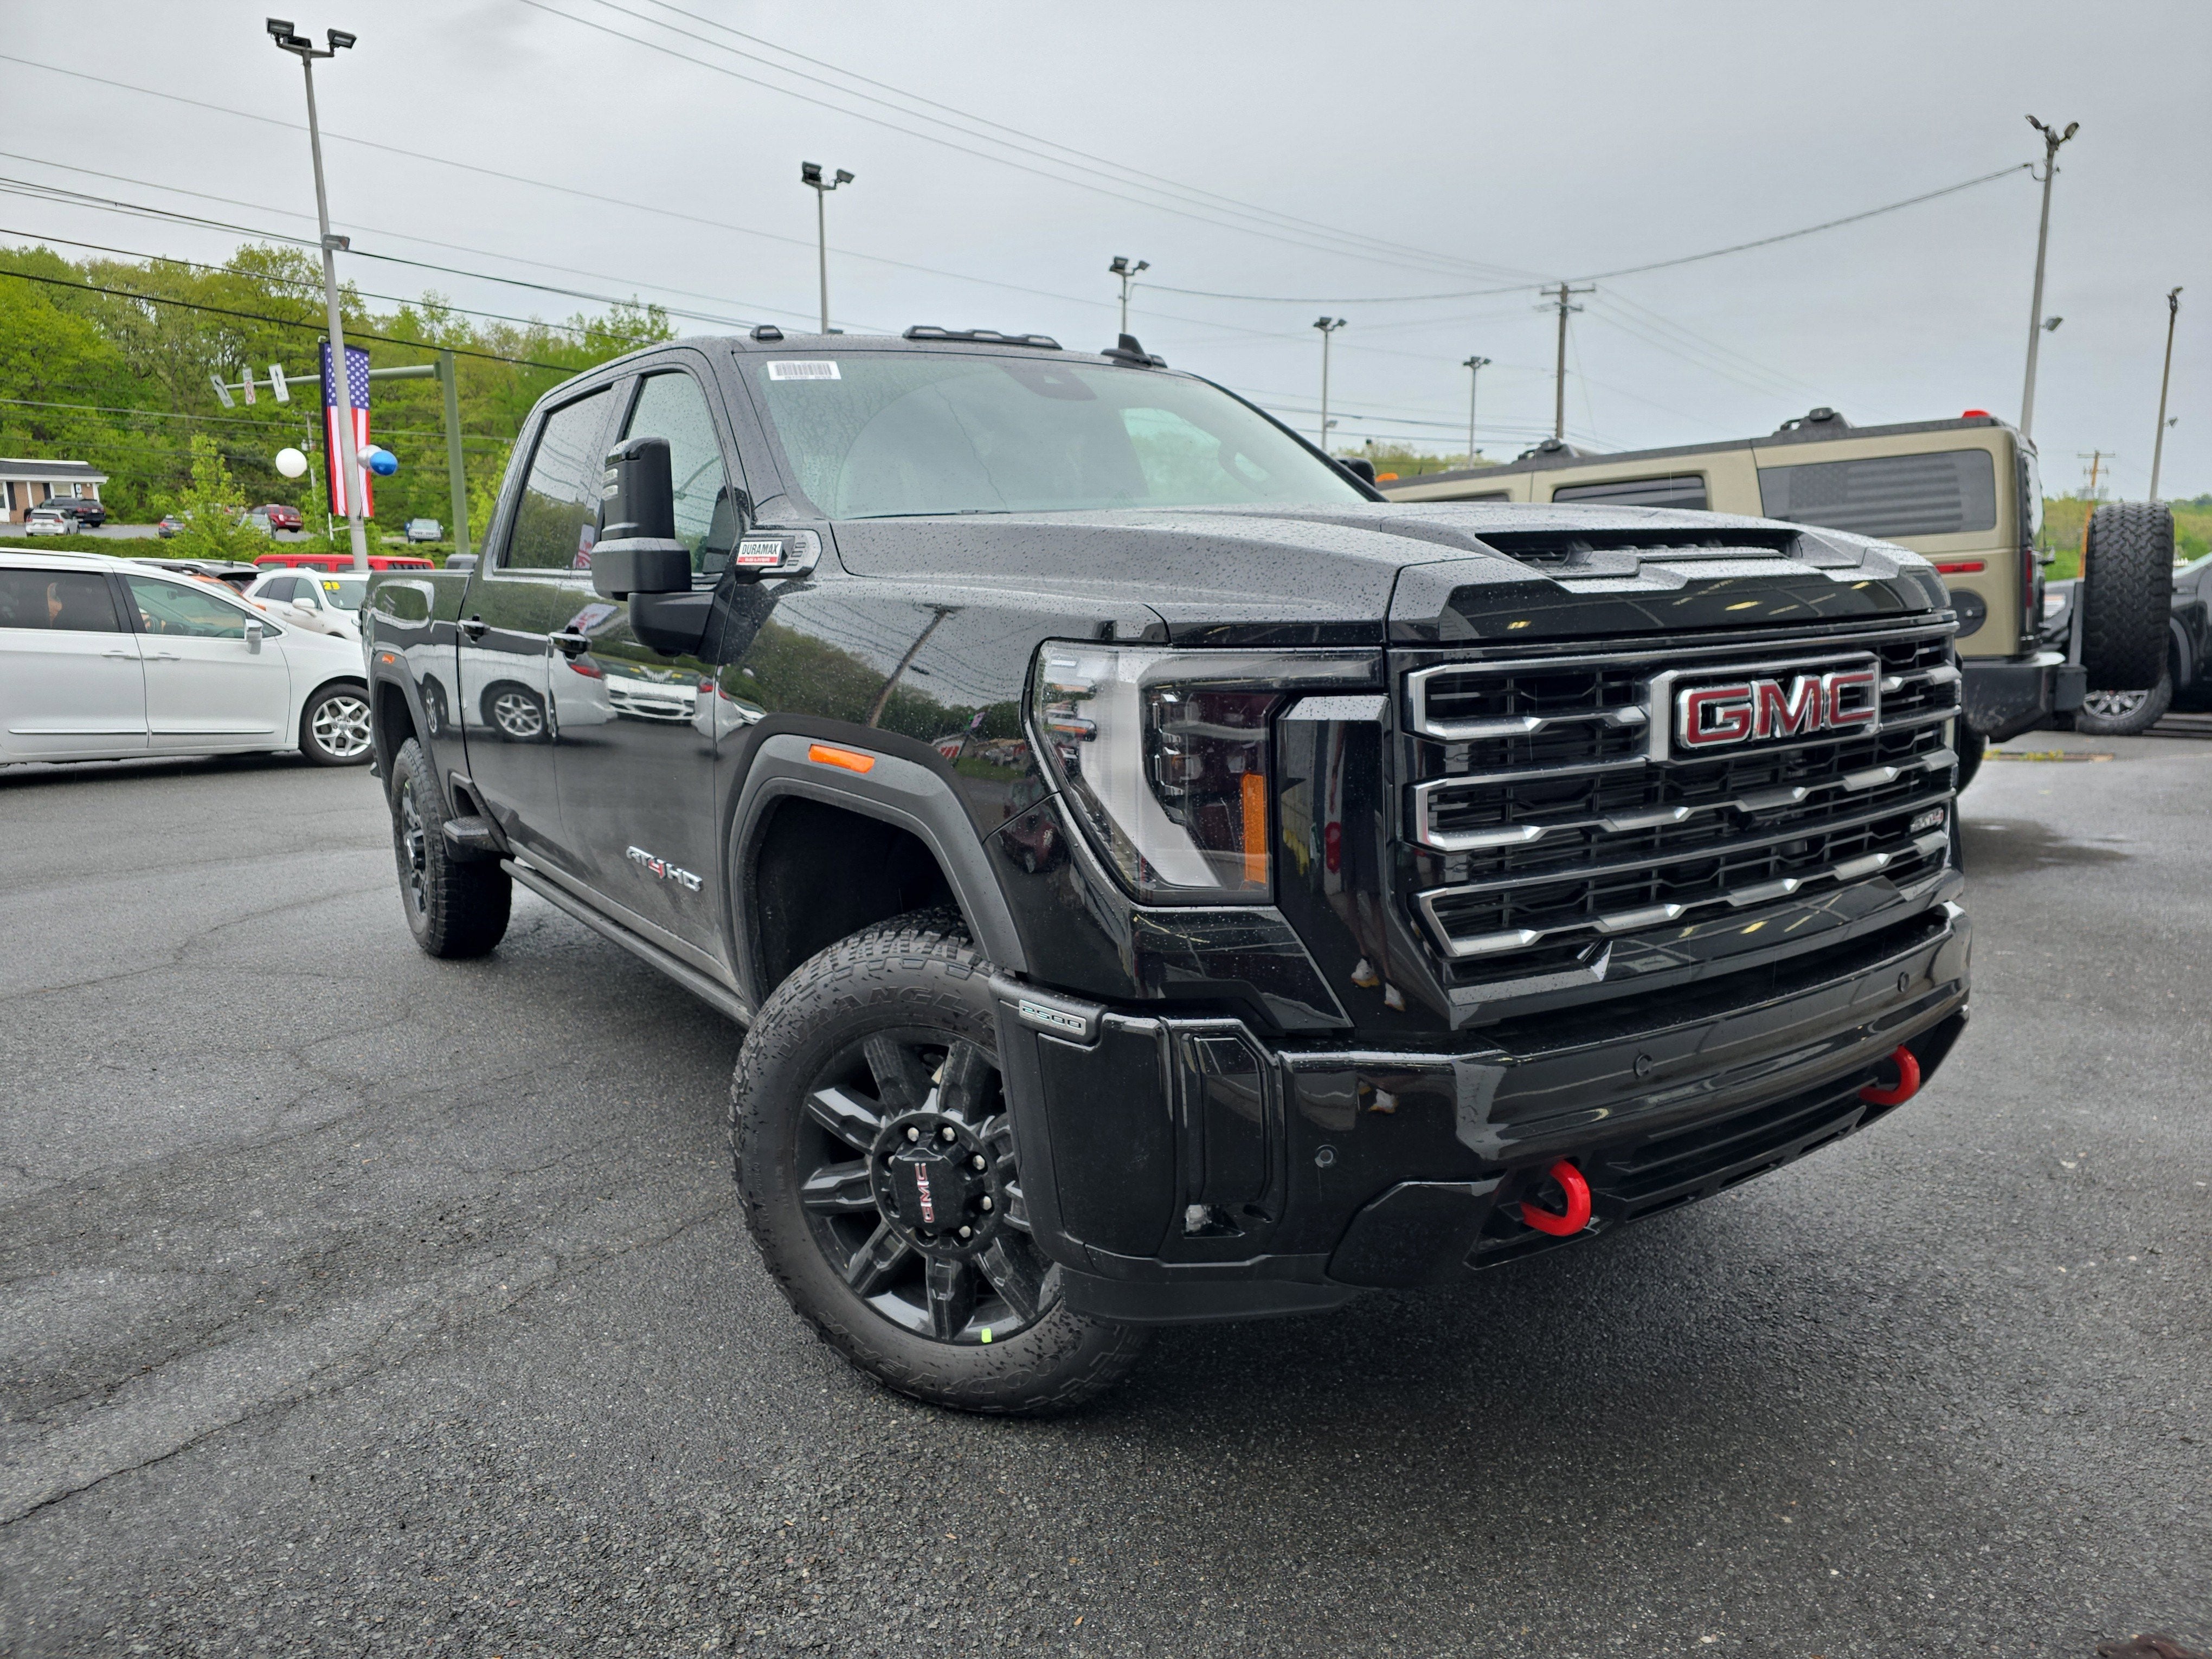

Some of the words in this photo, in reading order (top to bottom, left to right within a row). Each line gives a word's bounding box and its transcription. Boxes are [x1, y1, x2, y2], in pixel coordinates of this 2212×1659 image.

[742, 544, 779, 555] DURAMAX
[1677, 669, 1876, 749] GMC
[777, 986, 996, 1058] WRANGLE
[1022, 1006, 1082, 1030] 2500
[915, 1162, 935, 1223] GMC
